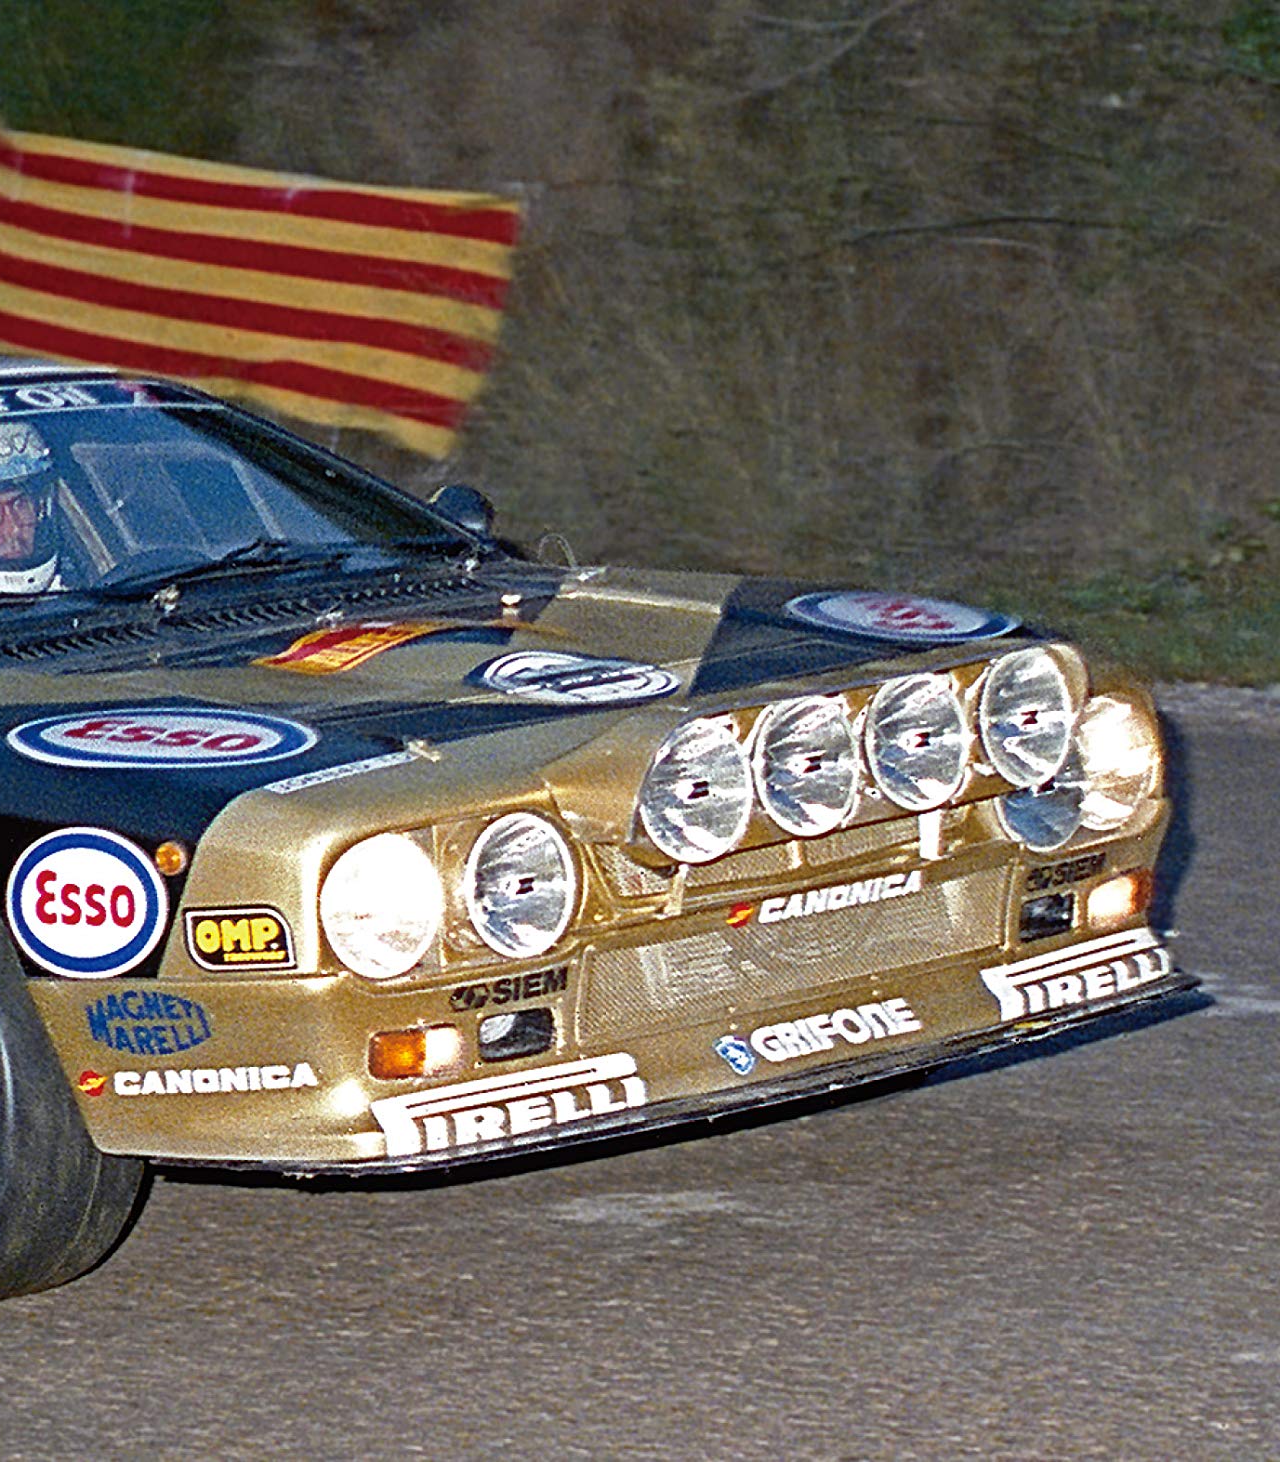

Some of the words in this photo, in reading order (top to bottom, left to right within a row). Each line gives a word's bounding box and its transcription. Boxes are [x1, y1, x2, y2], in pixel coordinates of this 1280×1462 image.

[16, 383, 99, 408] Oil
[35, 868, 136, 928] Esso
[758, 870, 922, 924] CANONICA
[492, 966, 569, 1006] SIEM
[980, 927, 1171, 1023] PIRELLI
[748, 998, 922, 1063] GRIFONE
[113, 1062, 319, 1096] CANONICA
[370, 1052, 648, 1158] PIRELLI
